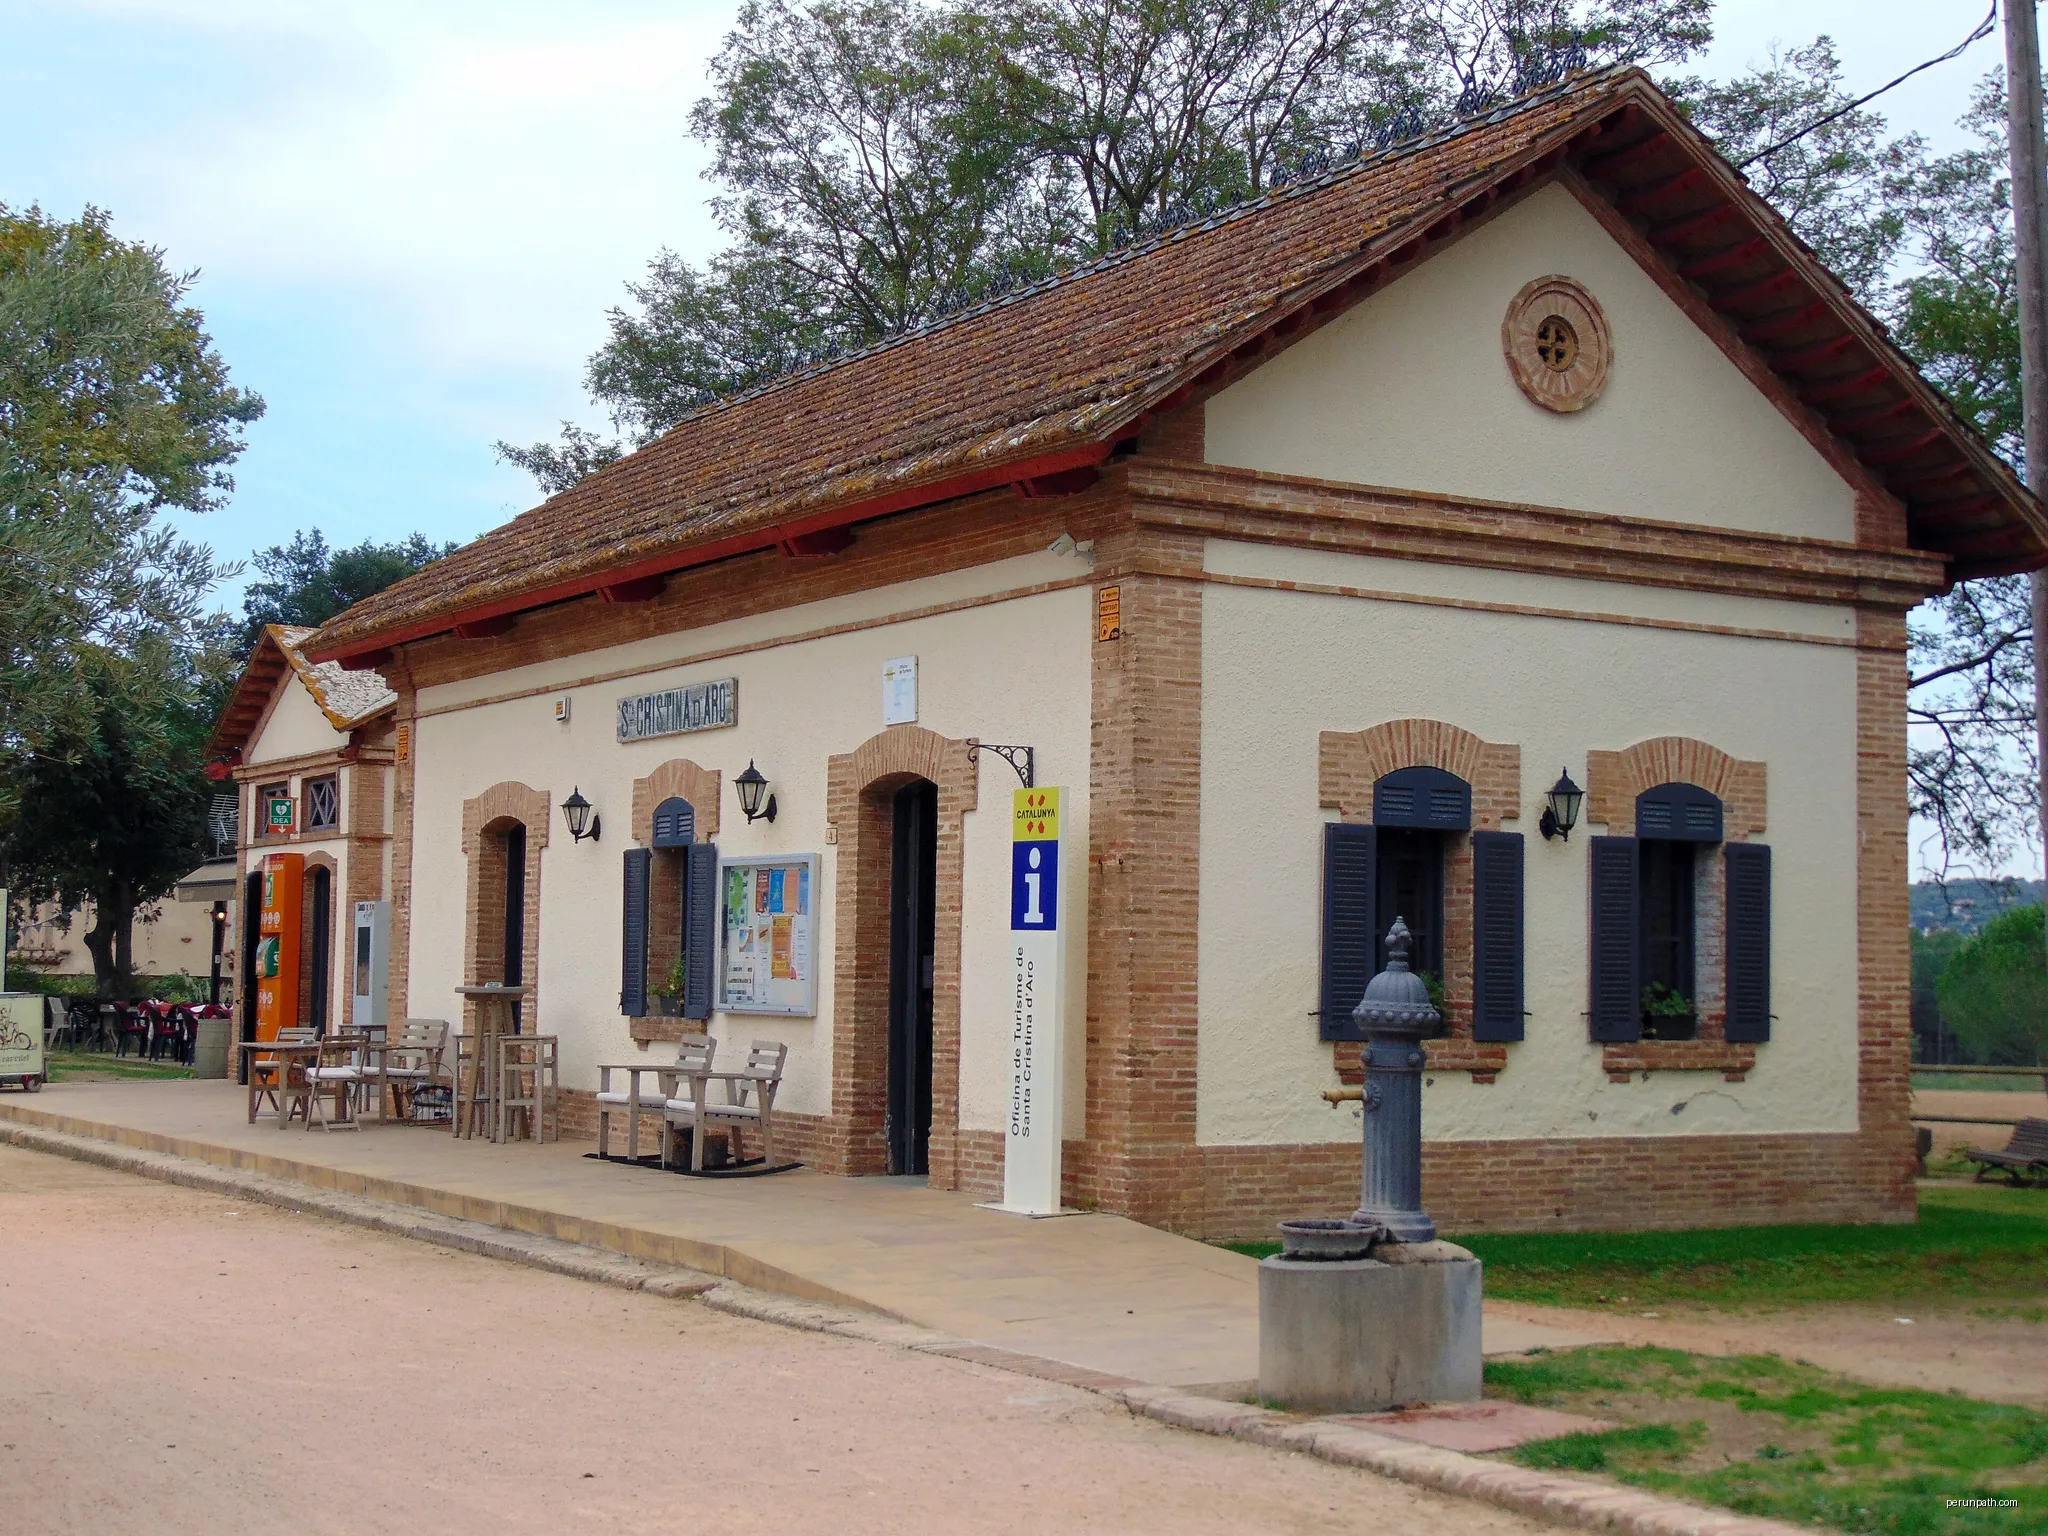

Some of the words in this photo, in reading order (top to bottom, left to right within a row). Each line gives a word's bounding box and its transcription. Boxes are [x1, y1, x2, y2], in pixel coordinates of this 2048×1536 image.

[636, 689, 690, 736] CRISTINA
[1016, 808, 1056, 819] CATALUNYA
[1016, 946, 1023, 967] de
[1014, 973, 1023, 1042] Turisme
[1025, 961, 1034, 1008] d'Aro
[1013, 1047, 1021, 1068] de
[1023, 1014, 1032, 1082] Cristina
[1011, 1075, 1020, 1136] Oficina
[1022, 1088, 1030, 1137] Santa
